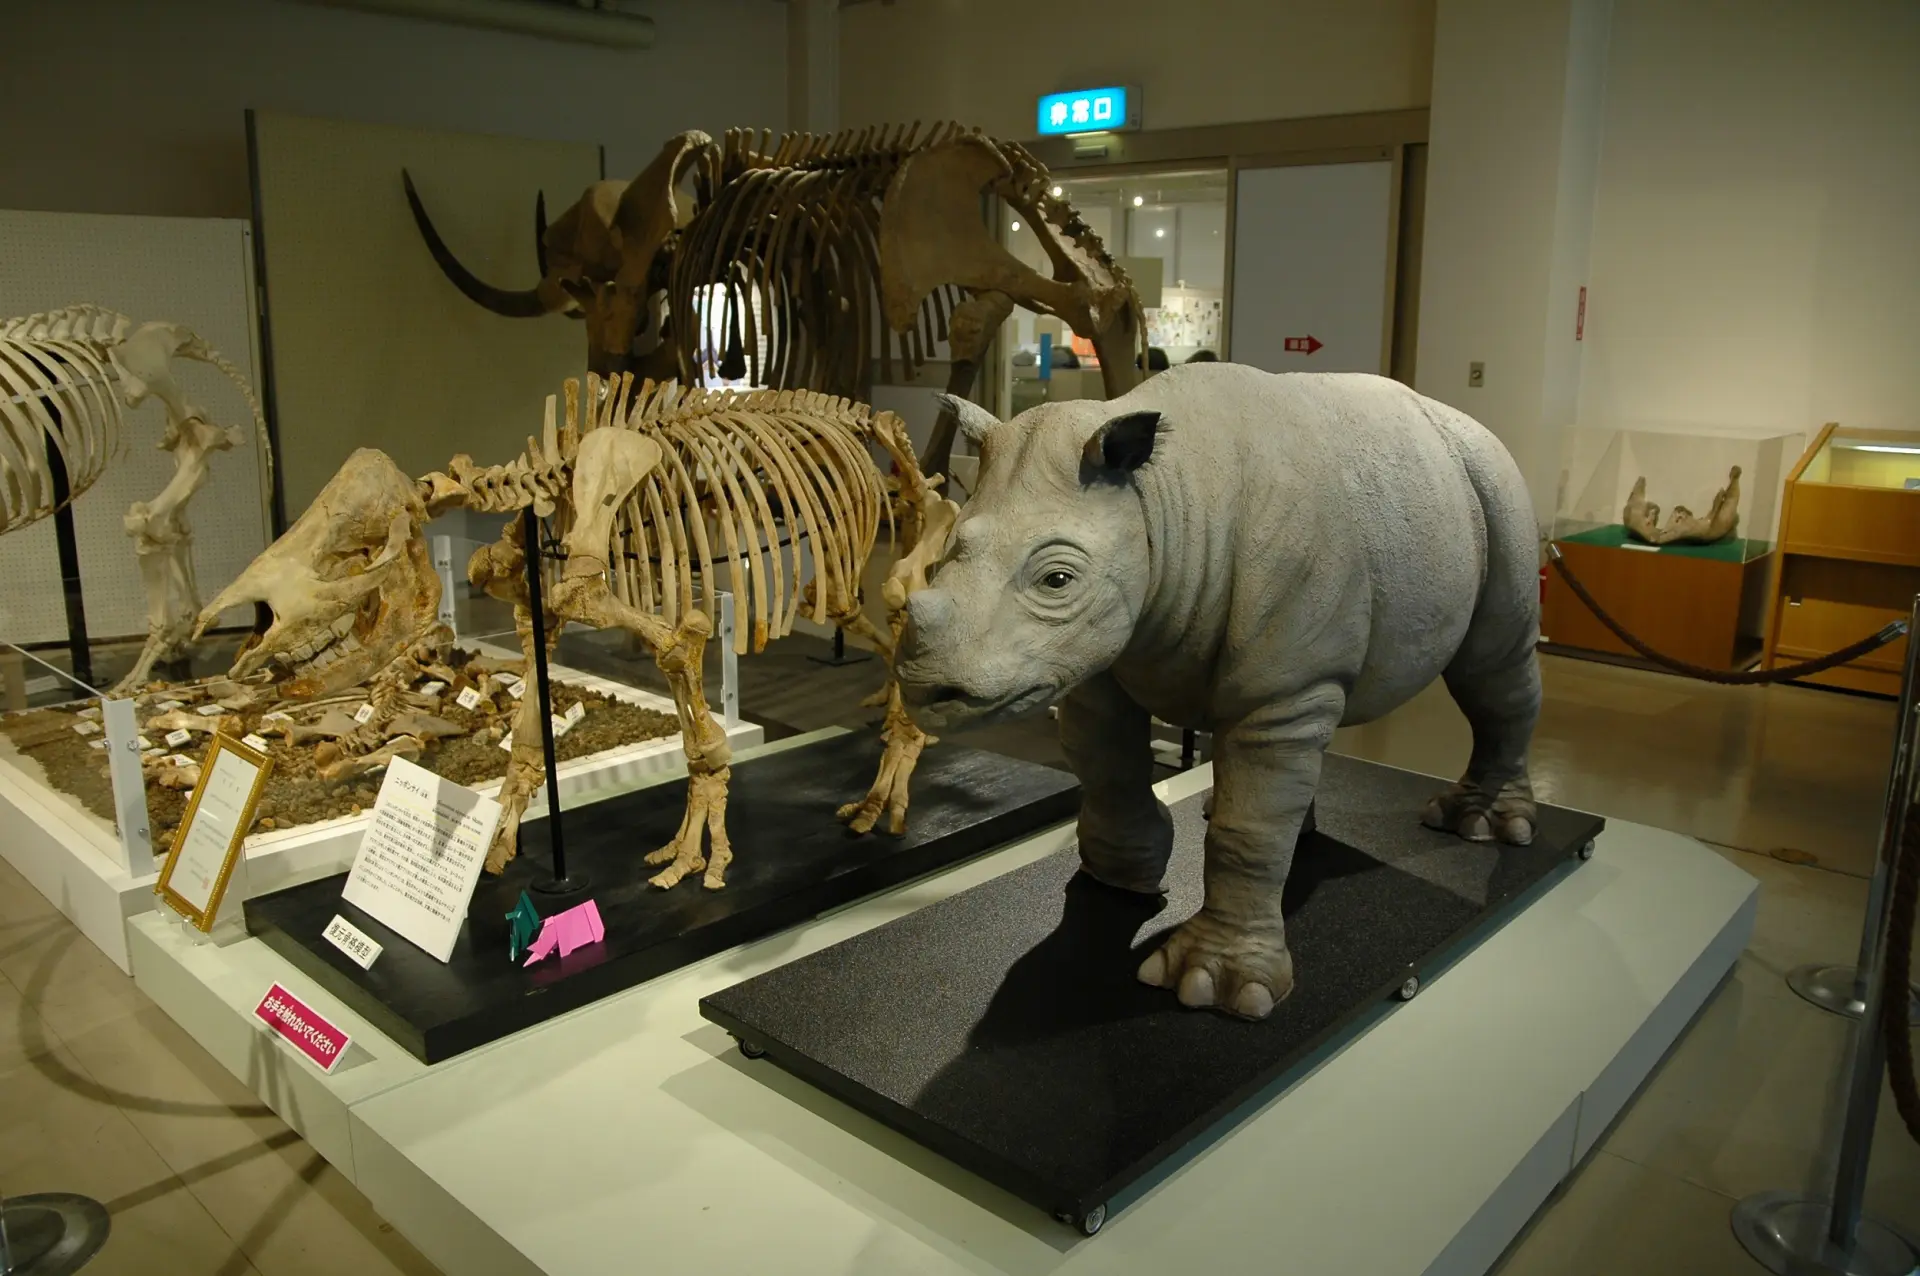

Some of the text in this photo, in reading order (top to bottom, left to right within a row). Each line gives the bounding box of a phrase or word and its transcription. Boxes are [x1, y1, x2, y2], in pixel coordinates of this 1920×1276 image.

[1050, 97, 1112, 126] 非常口
[329, 922, 372, 960] 復元骨格模型
[263, 997, 335, 1054] お手を触れないでください
